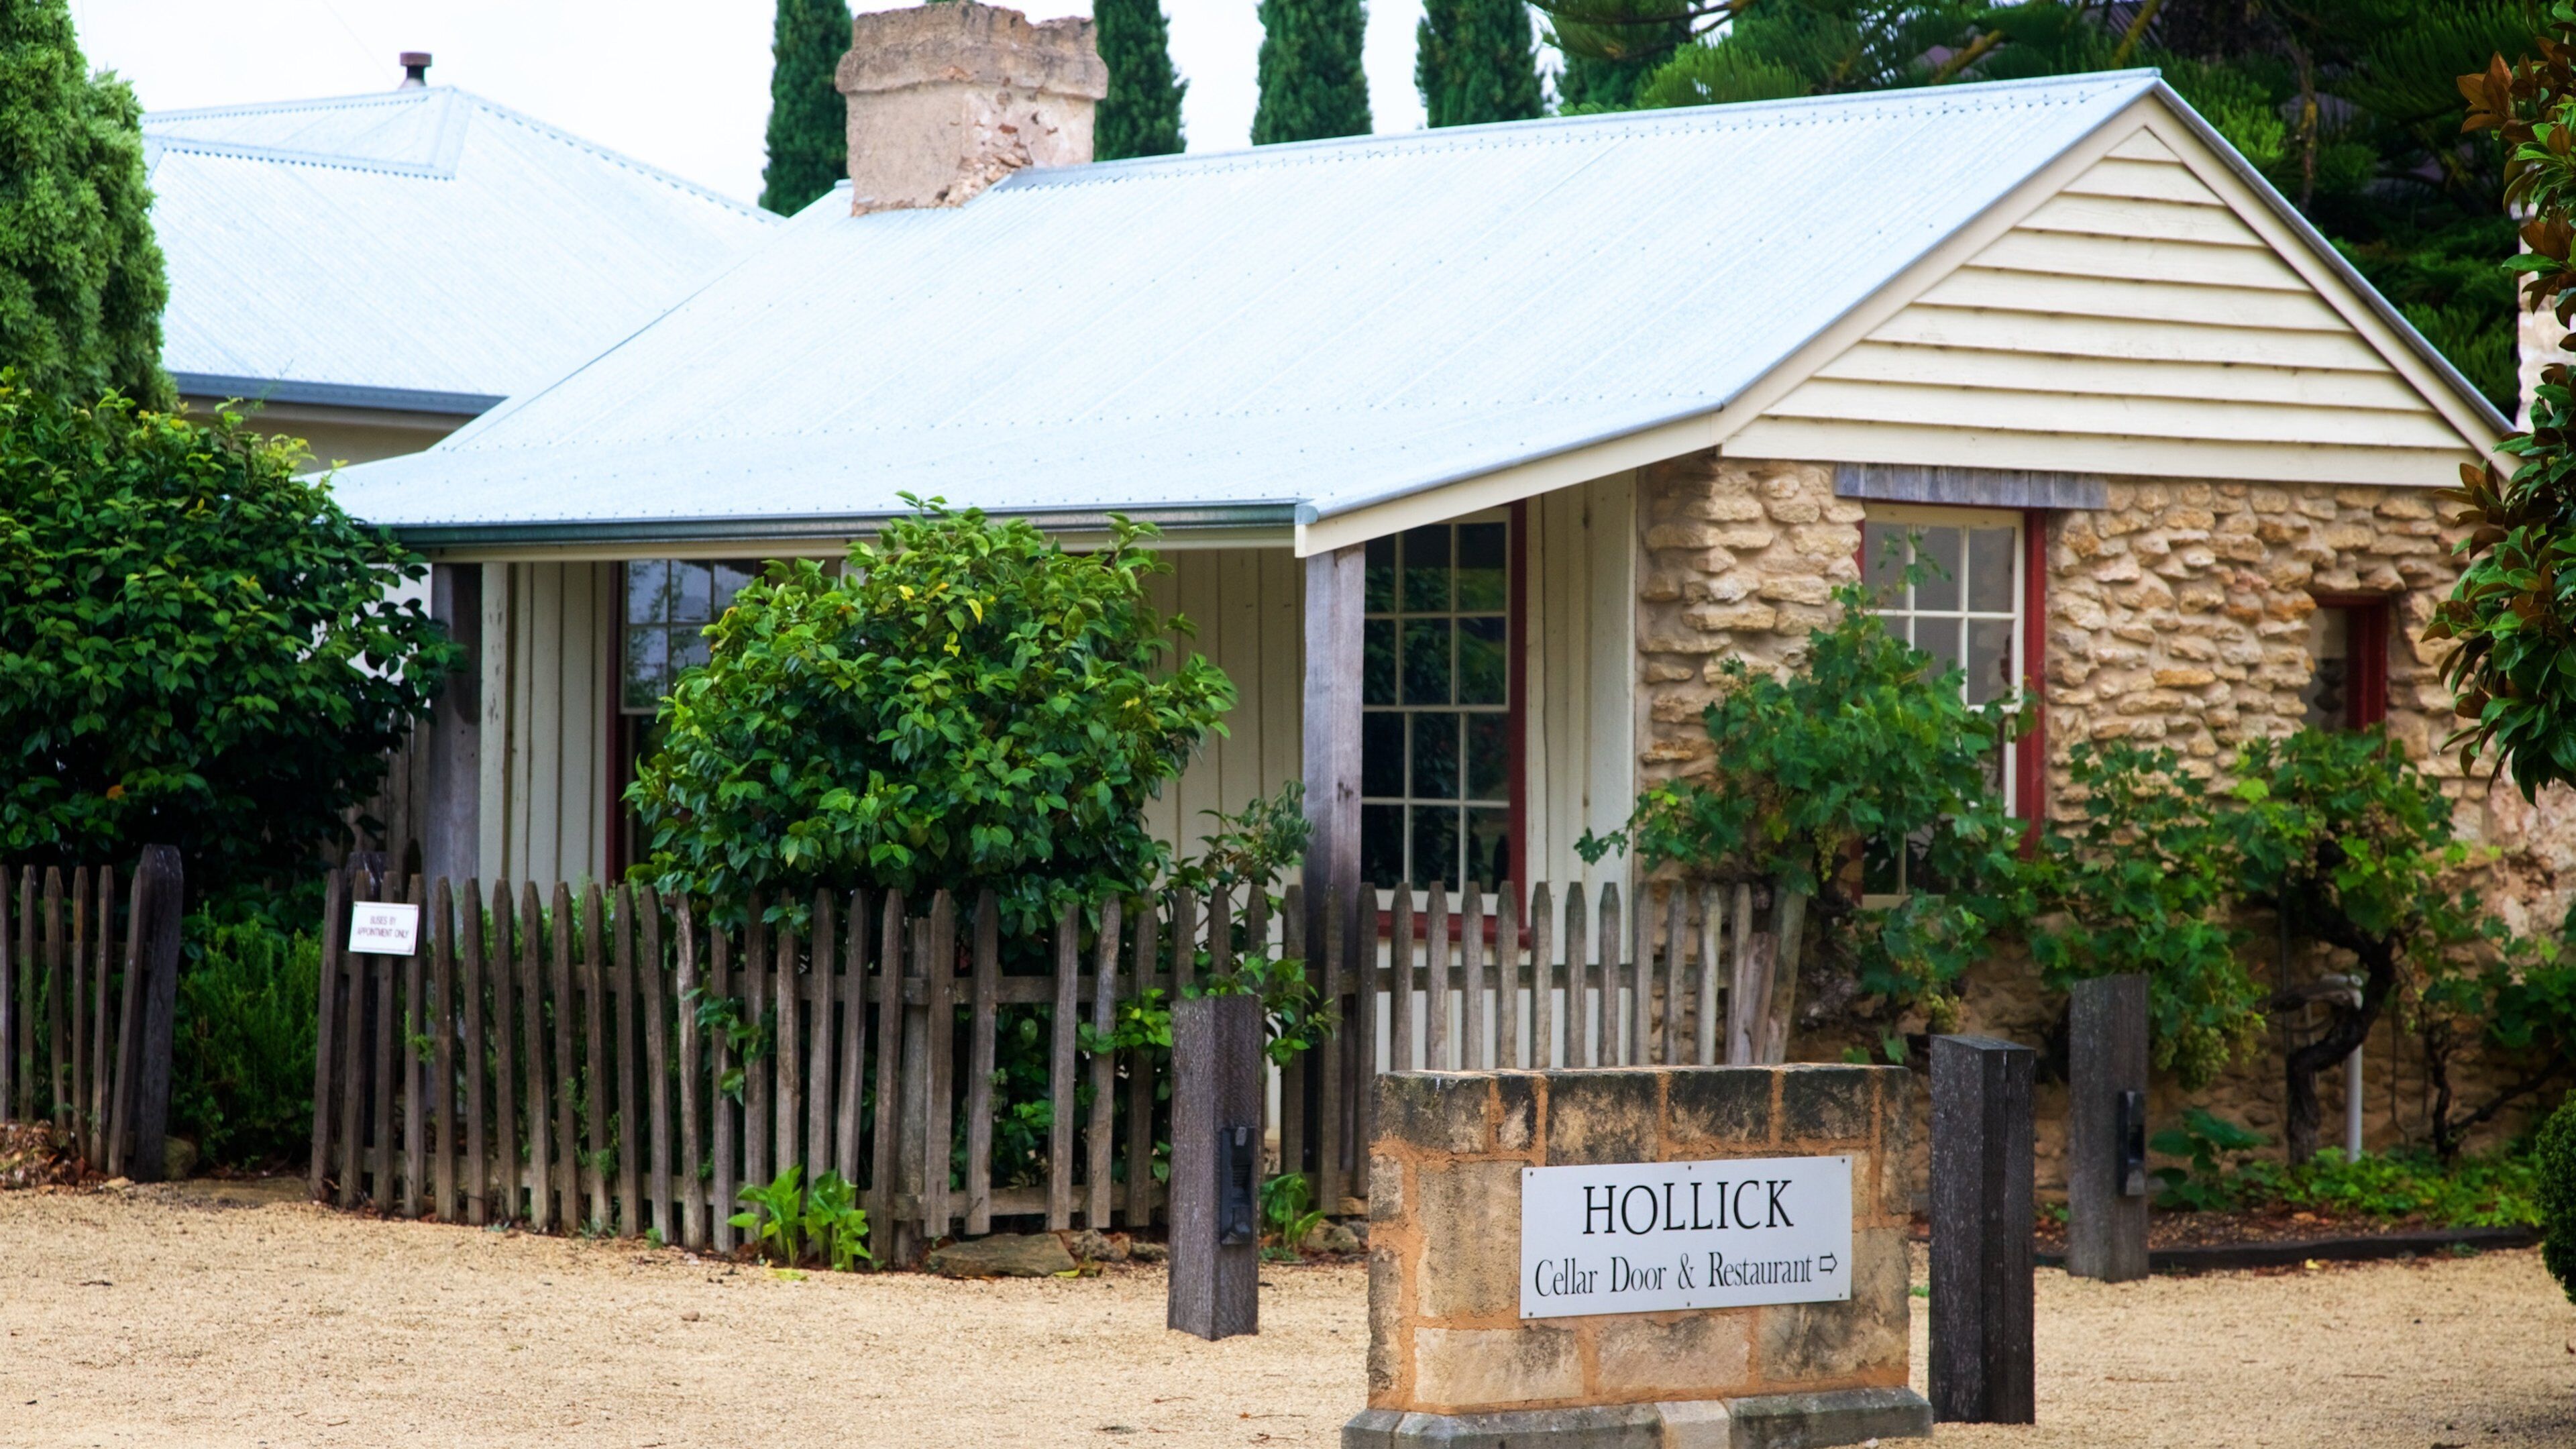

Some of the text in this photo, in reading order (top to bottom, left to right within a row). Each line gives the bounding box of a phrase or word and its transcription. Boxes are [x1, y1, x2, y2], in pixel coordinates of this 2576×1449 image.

[358, 927, 409, 938] APPOINTMENT ONLY
[389, 916, 396, 924] BY
[1582, 1179, 1794, 1236] HOLLICK
[1535, 1251, 1813, 1297] Cellar Door & Restaurant
